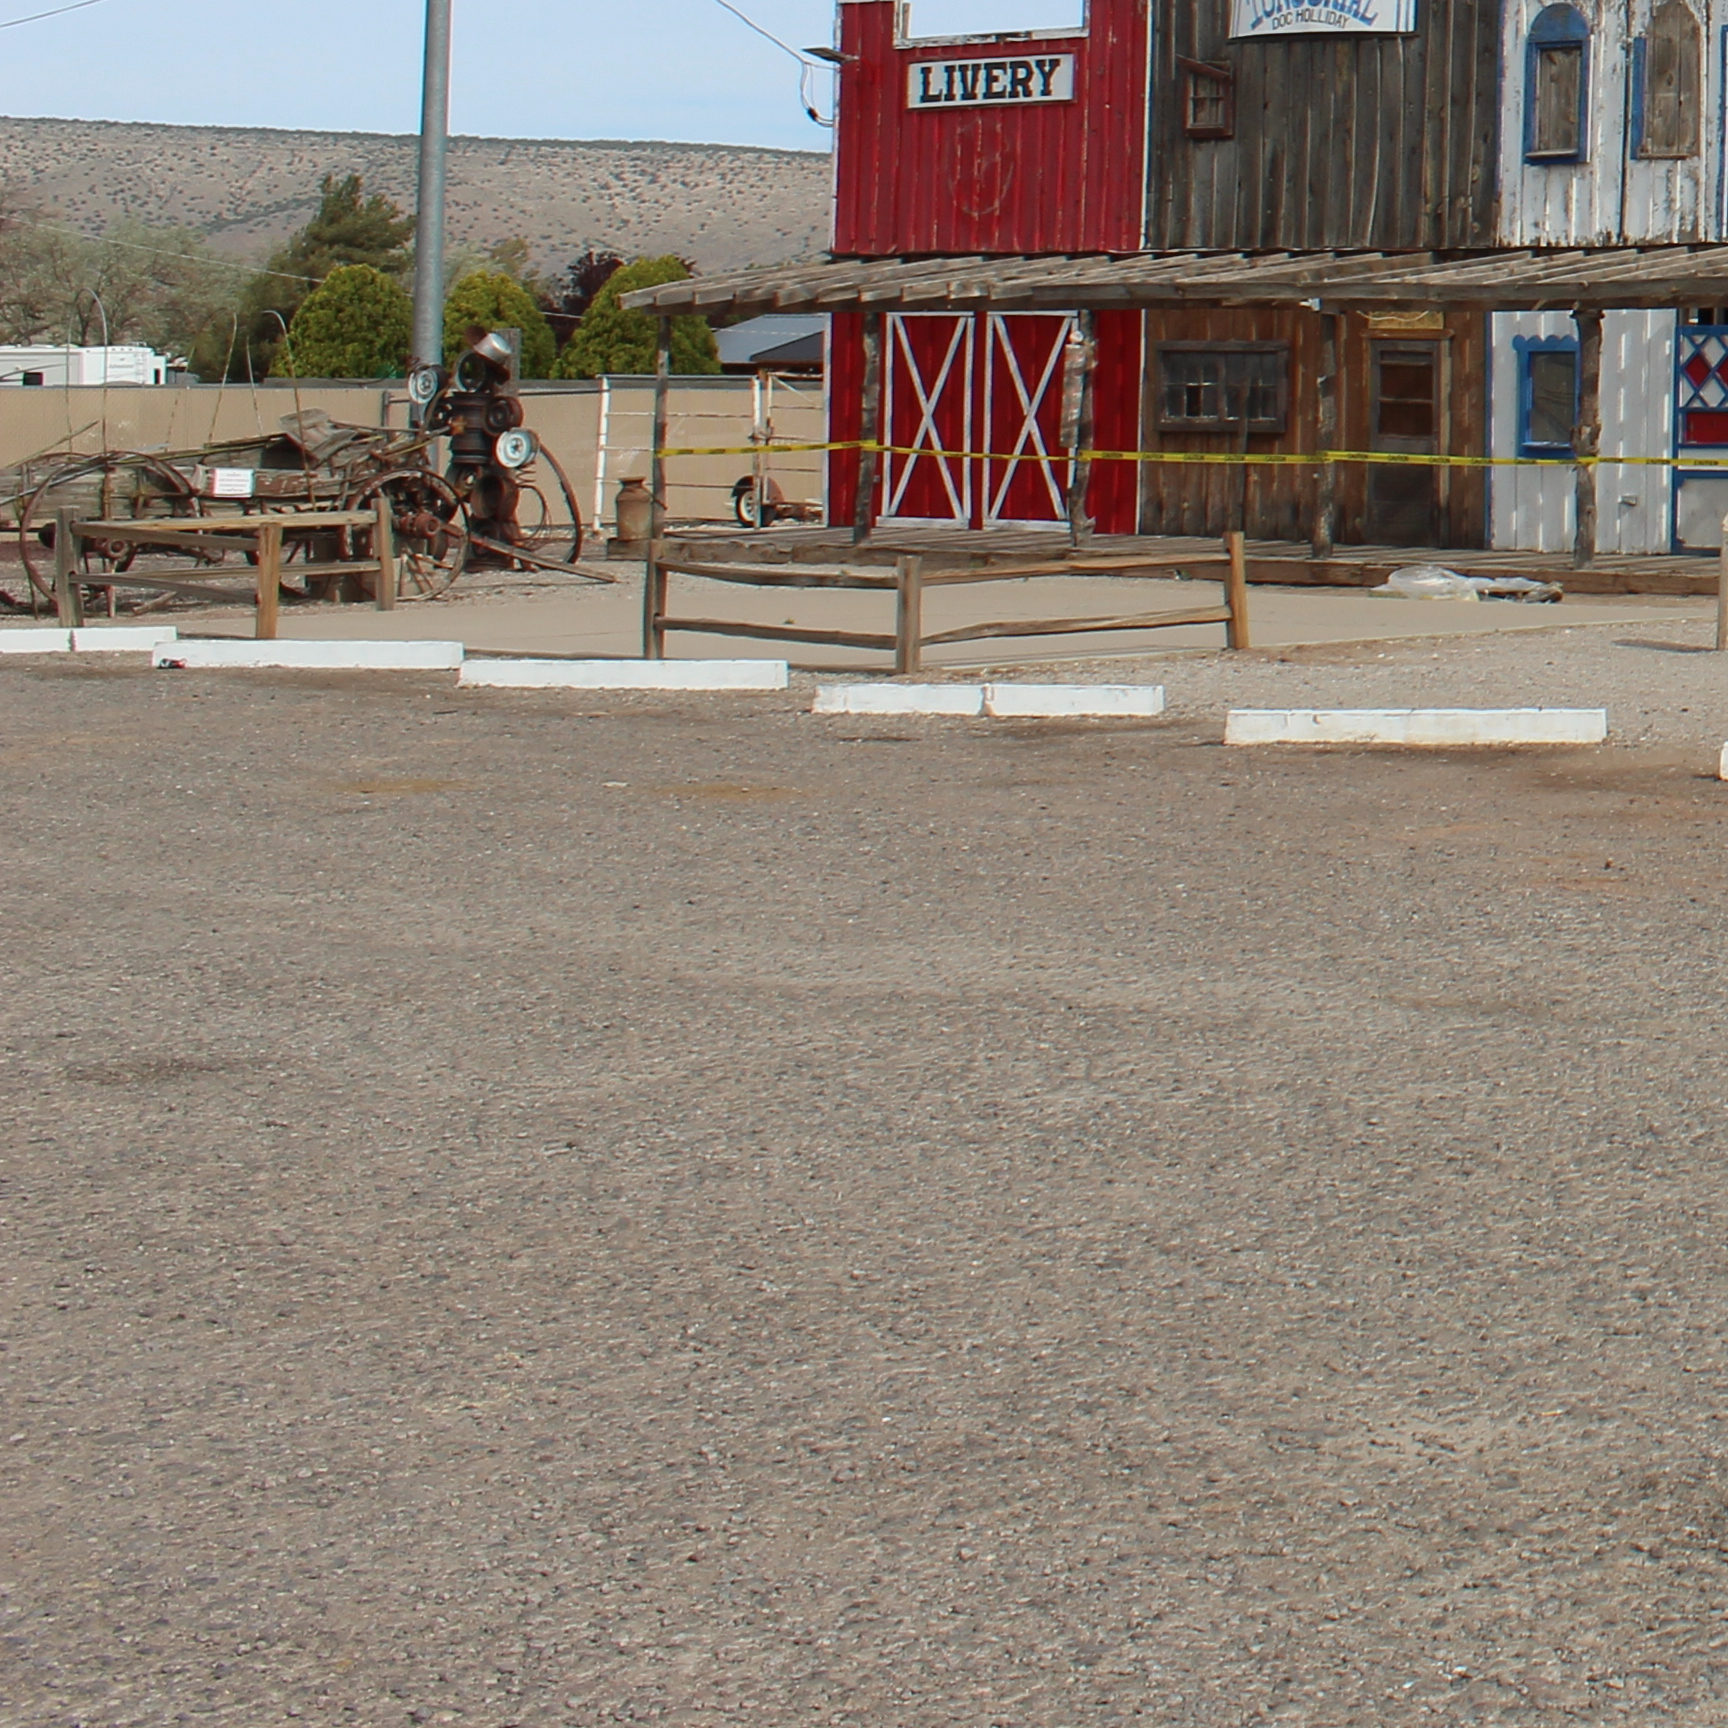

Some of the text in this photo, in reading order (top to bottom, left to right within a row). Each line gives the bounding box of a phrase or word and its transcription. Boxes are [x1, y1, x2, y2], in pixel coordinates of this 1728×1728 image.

[1271, 8, 1351, 30] DOC HOLLIDAY
[919, 58, 1062, 103] LIVERY
